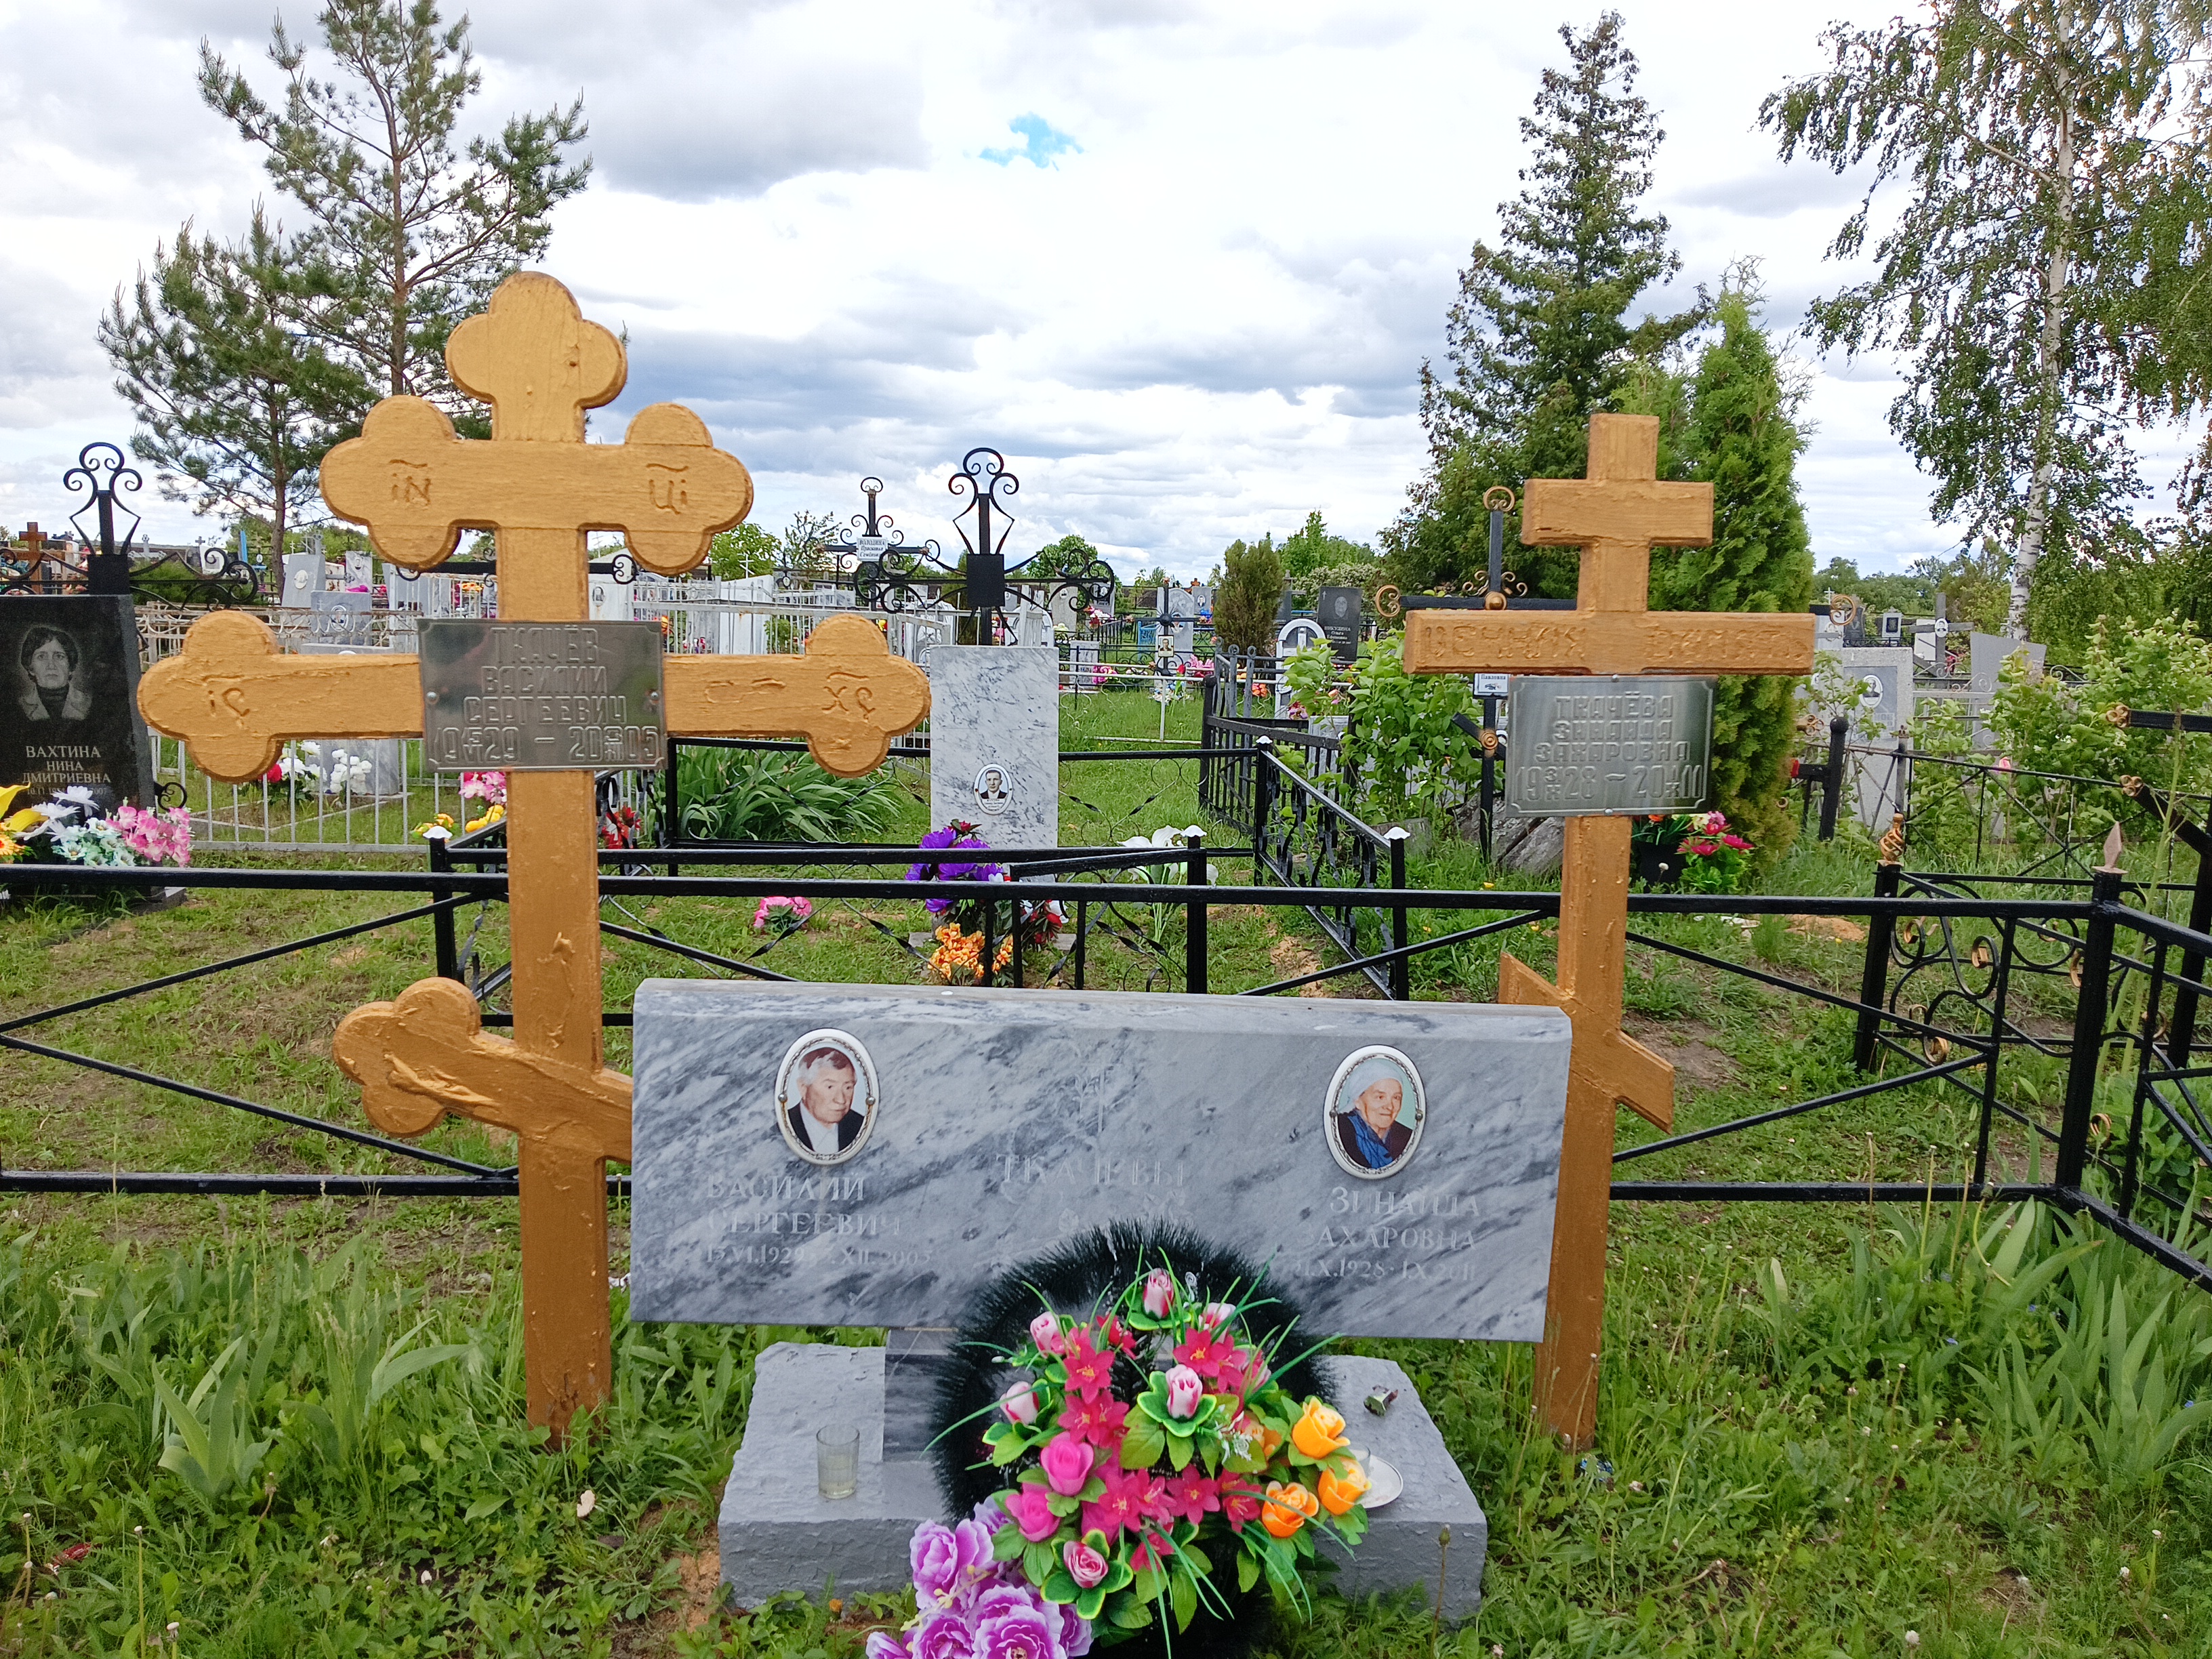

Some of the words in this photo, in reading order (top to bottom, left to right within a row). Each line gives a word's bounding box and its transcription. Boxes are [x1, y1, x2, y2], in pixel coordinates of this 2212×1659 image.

[464, 695, 628, 724] СЕРГЕЕВИЧ
[1555, 691, 1674, 718] ТКАЧЁВА
[1553, 719, 1673, 741] ЗИНАИДА
[26, 745, 102, 758] ВАХТИНА
[1534, 741, 1690, 762] ЗАХАРОВНА
[22, 772, 111, 783] ДМИТРИЕВНА
[46, 760, 84, 771] НИНА
[706, 1172, 865, 1202] ВАСИЛИЙ
[708, 1208, 902, 1236] СЕРГЕЕВИЧ
[1300, 1223, 1477, 1251] АХАРОВНА
